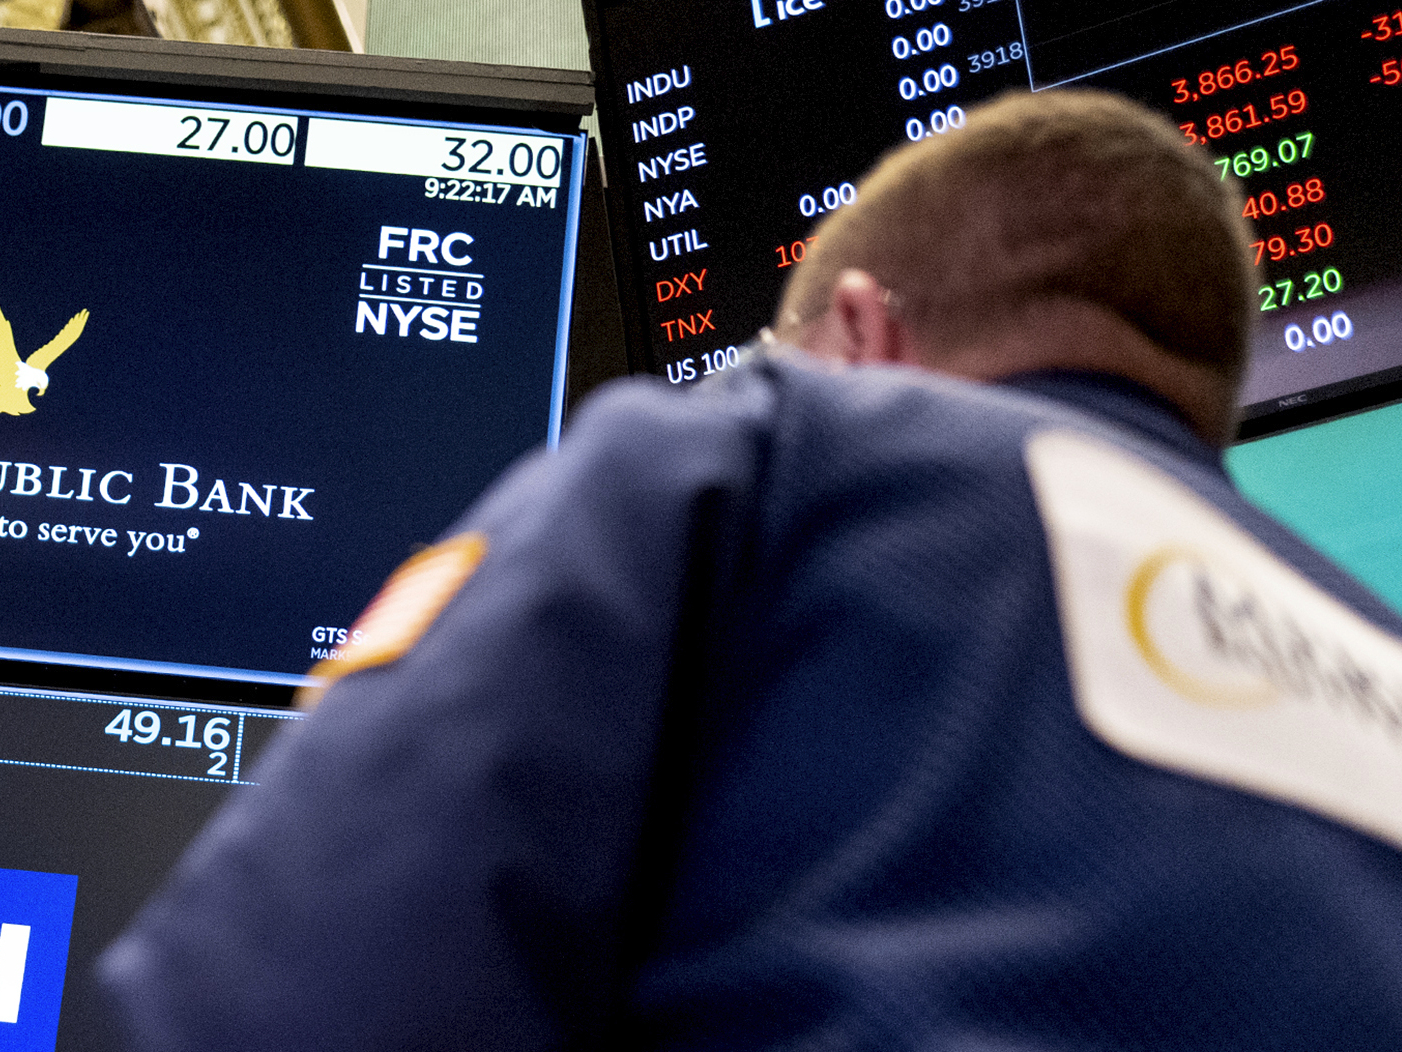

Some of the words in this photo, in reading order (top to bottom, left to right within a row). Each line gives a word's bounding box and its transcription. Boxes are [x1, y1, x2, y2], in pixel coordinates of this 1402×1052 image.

[892, 22, 952, 59] 0.00
[967, 42, 1023, 73] 3918
[627, 65, 692, 104] INDU
[899, 63, 960, 100] 0.00
[1171, 45, 1299, 103] 3,866.25
[1370, 60, 1402, 85] -5
[177, 115, 296, 157] 27.00
[632, 106, 696, 143] INDP
[905, 104, 966, 141] 0.00
[1179, 89, 1307, 146] 3,861.59
[442, 137, 561, 179] 32.00
[638, 143, 708, 182] NYSE
[424, 178, 510, 205] 9:22:17
[516, 187, 557, 209] AM
[644, 189, 699, 222] NYA
[799, 182, 857, 217] 0.00
[1241, 178, 1325, 219] 40.88
[378, 225, 474, 267] FRC
[649, 229, 709, 261] UTIL
[1248, 222, 1333, 266] 79.30
[359, 272, 484, 300] LISTED
[656, 268, 707, 302] DXY
[1258, 267, 1342, 312] 27.20
[355, 301, 480, 344] NYSE
[661, 309, 716, 342] TNX
[1284, 311, 1353, 352] 0.00
[667, 358, 697, 384] US
[701, 346, 740, 376] 100
[37, 521, 117, 547] serve
[311, 625, 348, 645] GTS
[310, 647, 350, 661] MARK
[104, 708, 231, 751] 49.16
[206, 750, 228, 776] 2
